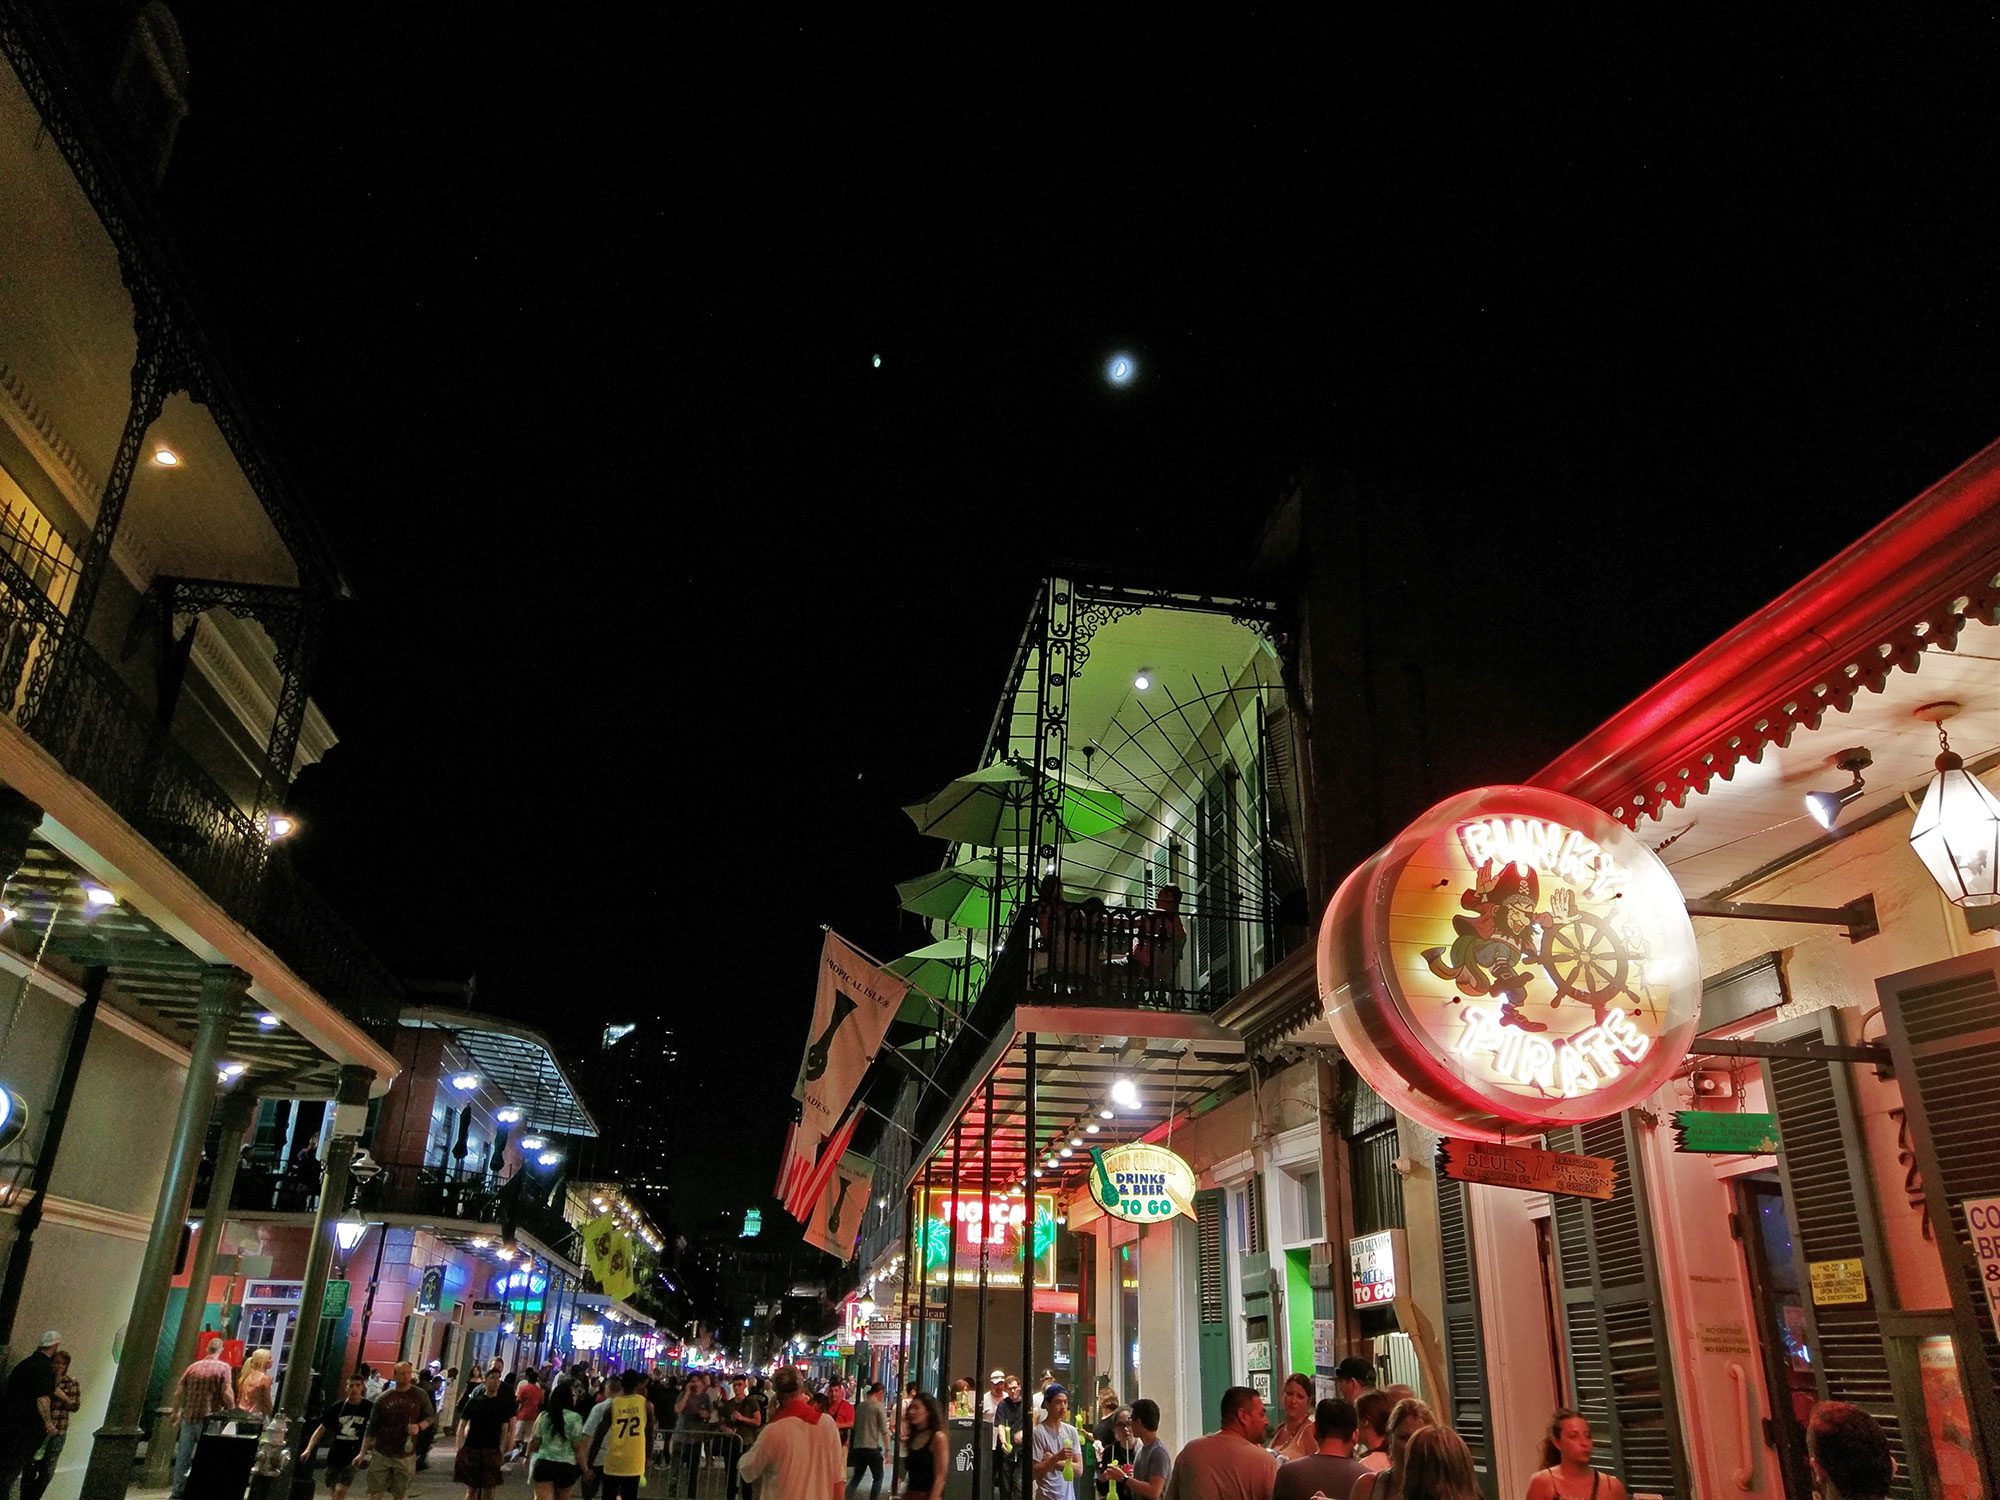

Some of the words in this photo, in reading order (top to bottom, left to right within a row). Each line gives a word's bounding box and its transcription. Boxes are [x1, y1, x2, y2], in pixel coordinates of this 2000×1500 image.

[826, 957, 863, 993] TROPICAL
[1456, 1007, 1650, 1098] PIRATE
[1692, 1128, 1717, 1136] HAND
[1721, 1129, 1770, 1138] GRENADES
[1107, 1153, 1130, 1174] HAND
[1467, 1154, 1527, 1173] BLUES
[1554, 1156, 1599, 1170] FEATURING
[1116, 1173, 1165, 1184] DRINKS
[1547, 1171, 1611, 1187] CARSON
[1581, 1169, 1600, 1178] AL
[1119, 1184, 1129, 1195] &
[1133, 1184, 1164, 1195] BEER
[1121, 1200, 1142, 1215] TO
[1148, 1200, 1171, 1215] GO
[992, 1246, 1020, 1255] STREET
[1351, 1241, 1364, 1256] HAND
[1355, 1286, 1371, 1303] TO
[1374, 1282, 1393, 1300] GO
[912, 1307, 946, 1318] Olean
[870, 1322, 887, 1330] CIGAR
[888, 1322, 901, 1330] SHO
[1255, 1376, 1268, 1387] CASH
[617, 1416, 640, 1439] 72
